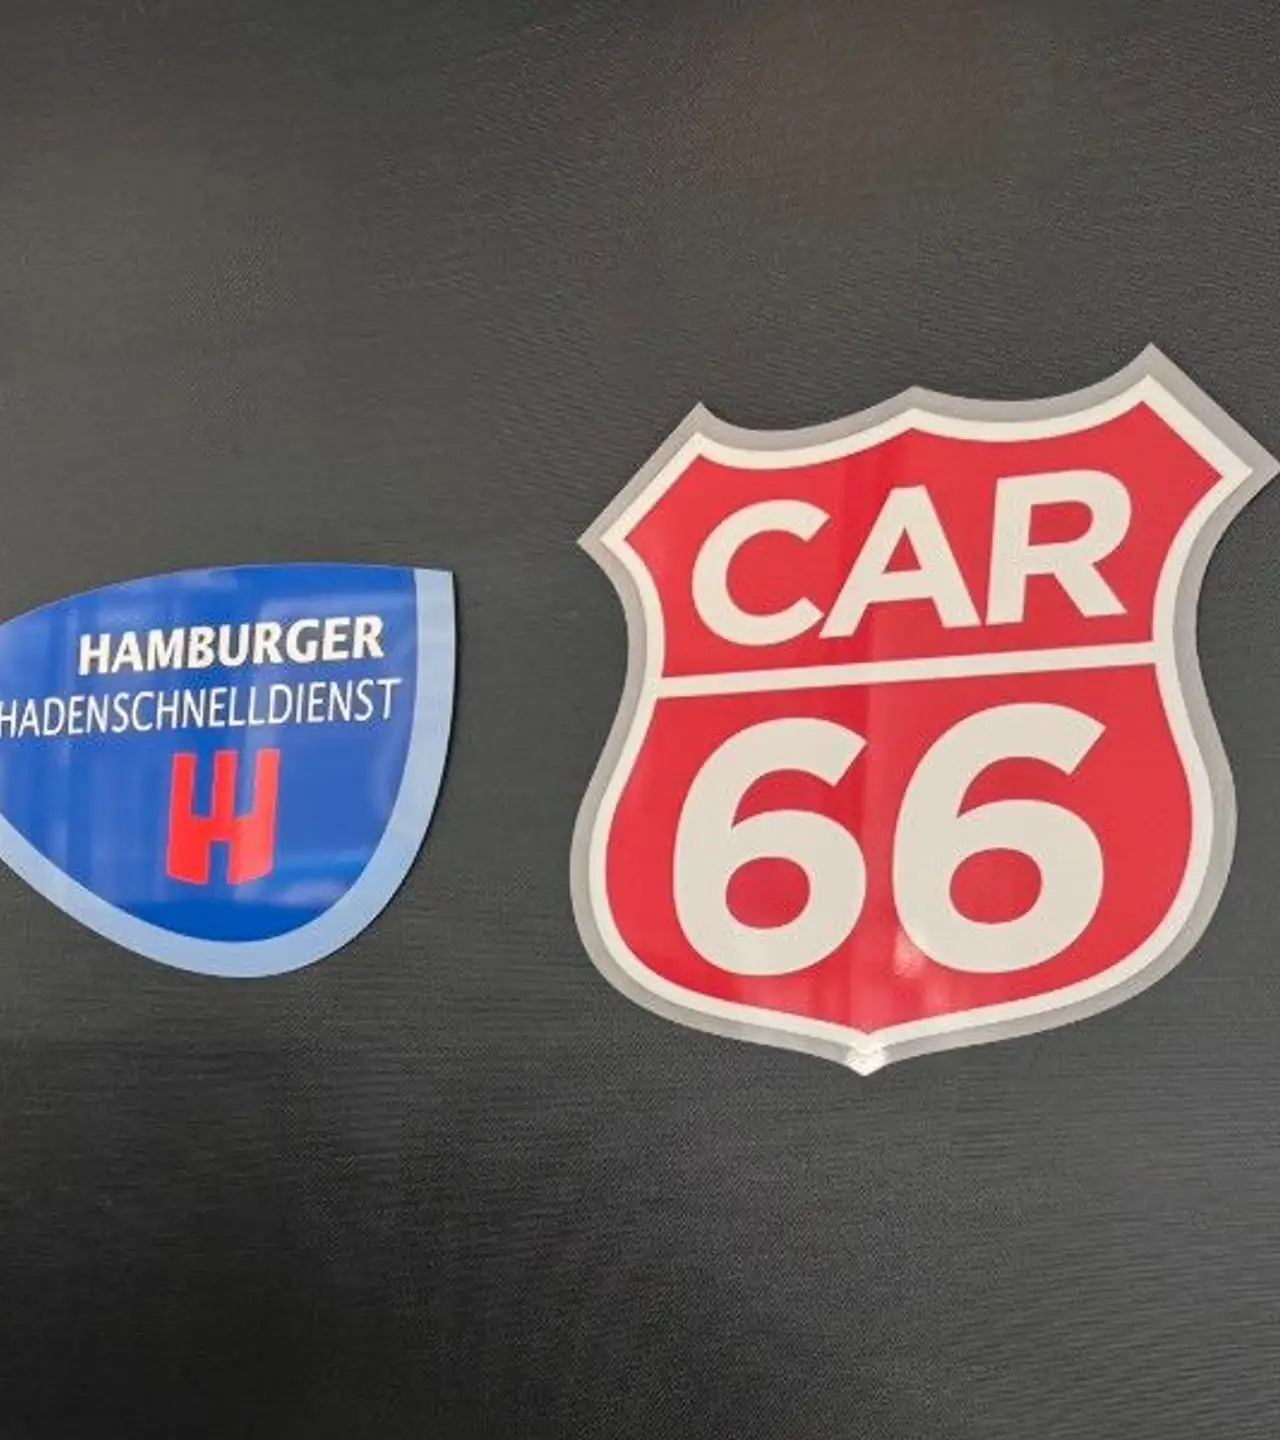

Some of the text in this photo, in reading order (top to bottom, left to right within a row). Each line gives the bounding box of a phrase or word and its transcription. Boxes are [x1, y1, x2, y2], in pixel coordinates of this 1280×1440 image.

[77, 615, 385, 676] HAMBURGER
[691, 468, 1133, 646] CAR
[672, 702, 1107, 977] 66
